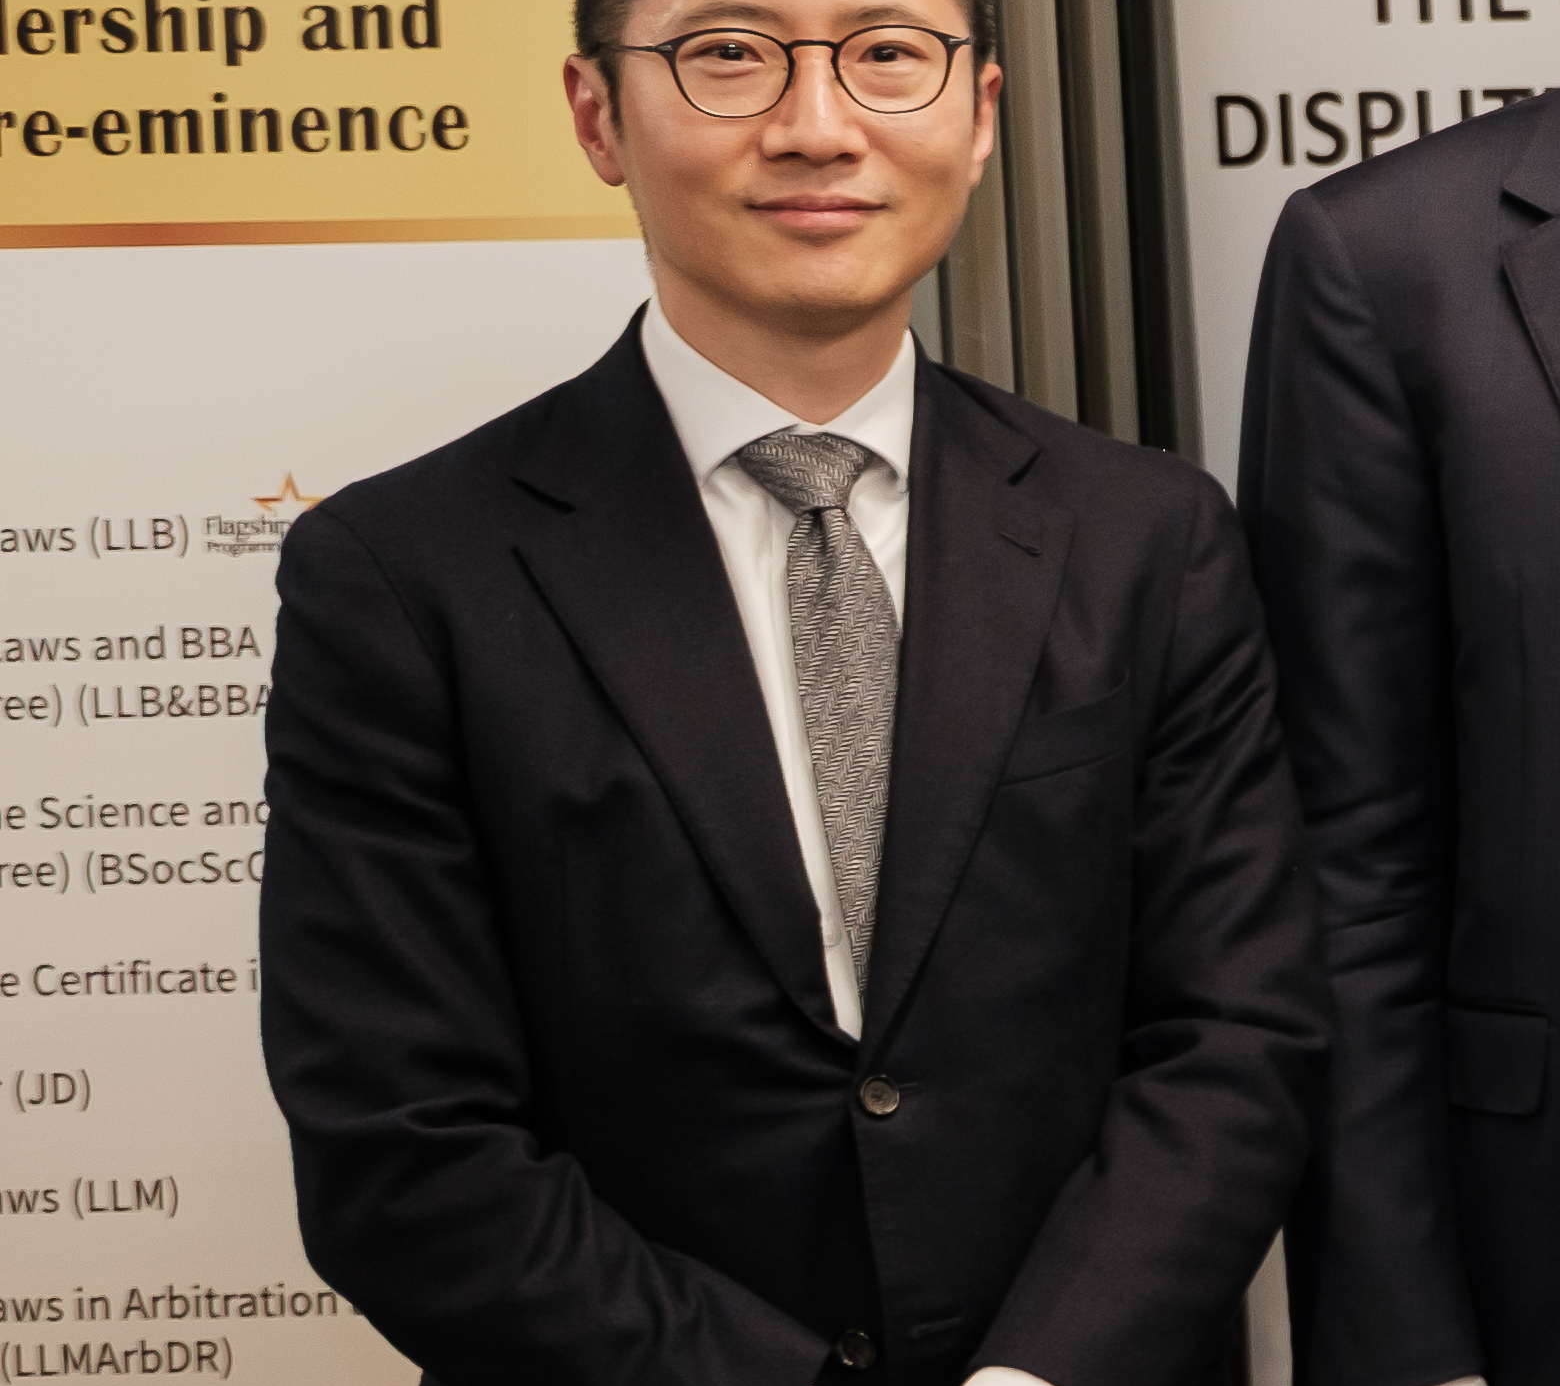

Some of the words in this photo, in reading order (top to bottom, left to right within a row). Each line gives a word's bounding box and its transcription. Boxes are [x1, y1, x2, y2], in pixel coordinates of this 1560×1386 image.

[0, 527, 77, 553] aws
[90, 514, 189, 559] (LLB)
[0, 637, 81, 662] aws
[94, 625, 166, 662] and
[180, 625, 262, 660] BBA
[0, 683, 63, 728] ee)
[38, 793, 190, 830] Science
[33, 959, 238, 997] Certificate
[14, 1069, 92, 1112] (JD)
[0, 1189, 61, 1214] ws
[71, 1174, 180, 1220] (LLM)
[73, 1285, 112, 1321] in
[122, 1283, 340, 1321] Arbitration
[0, 1335, 233, 1385] (LLMArbDR)
